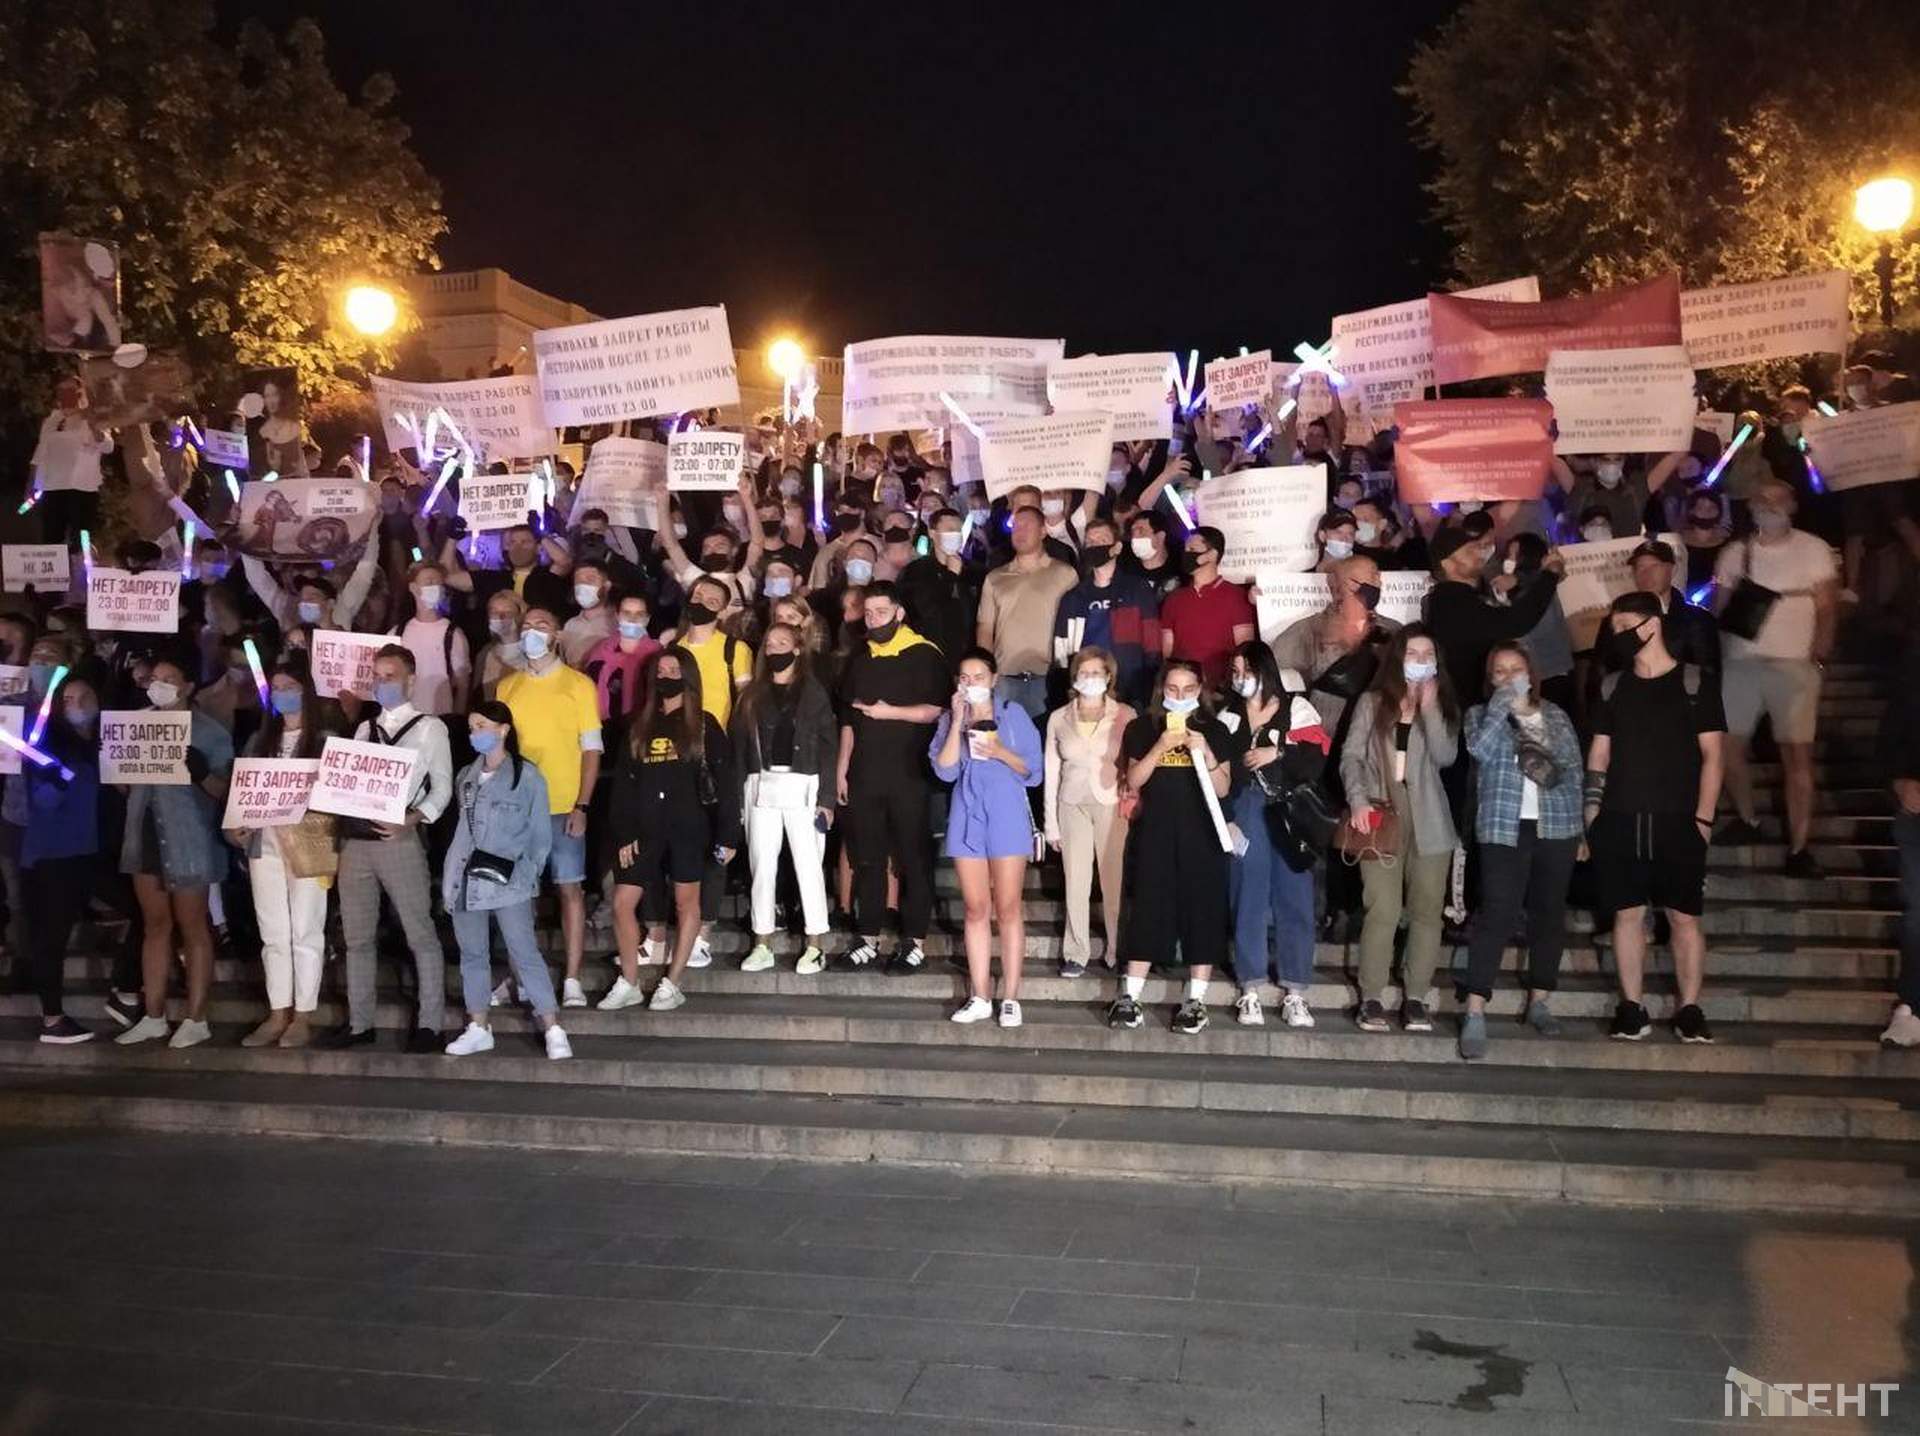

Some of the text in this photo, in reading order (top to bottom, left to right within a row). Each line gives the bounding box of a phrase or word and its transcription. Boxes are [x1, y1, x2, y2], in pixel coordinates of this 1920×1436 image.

[603, 328, 653, 347] ЗАПРЕТ
[656, 319, 711, 339] РАБОТЫ
[608, 352, 650, 369] ПОСЛЕ
[1208, 358, 1269, 384] НЕТ ЗАПРЕТУ
[562, 381, 622, 401] ЗАПРЕТИТЬ
[626, 372, 675, 393] ЛОВИТЬ
[680, 364, 737, 385] БЕЛОЧКУ
[484, 384, 532, 401] РАБОТЫ
[582, 402, 619, 420] ПОСЛЕ
[670, 442, 741, 457] НЕТ ЗАПРЕТУ
[674, 459, 700, 471] 23:00
[707, 459, 735, 471] 07:00
[463, 483, 529, 500] НЕТ ЗАПРЕТУ
[92, 578, 177, 597] НЕТ ЗАПРЕТУ
[316, 641, 336, 658] НЕТ
[102, 723, 188, 742] НЕТ ЗАПРЕТУ
[109, 745, 140, 760] 23:00
[151, 745, 182, 760] 07:00
[324, 750, 412, 779] НЕТ ЗАПРЕТУ
[235, 770, 260, 788] НЕТ
[325, 772, 358, 791] 23:00
[367, 779, 400, 798] 07:00
[238, 791, 270, 806] 23:00
